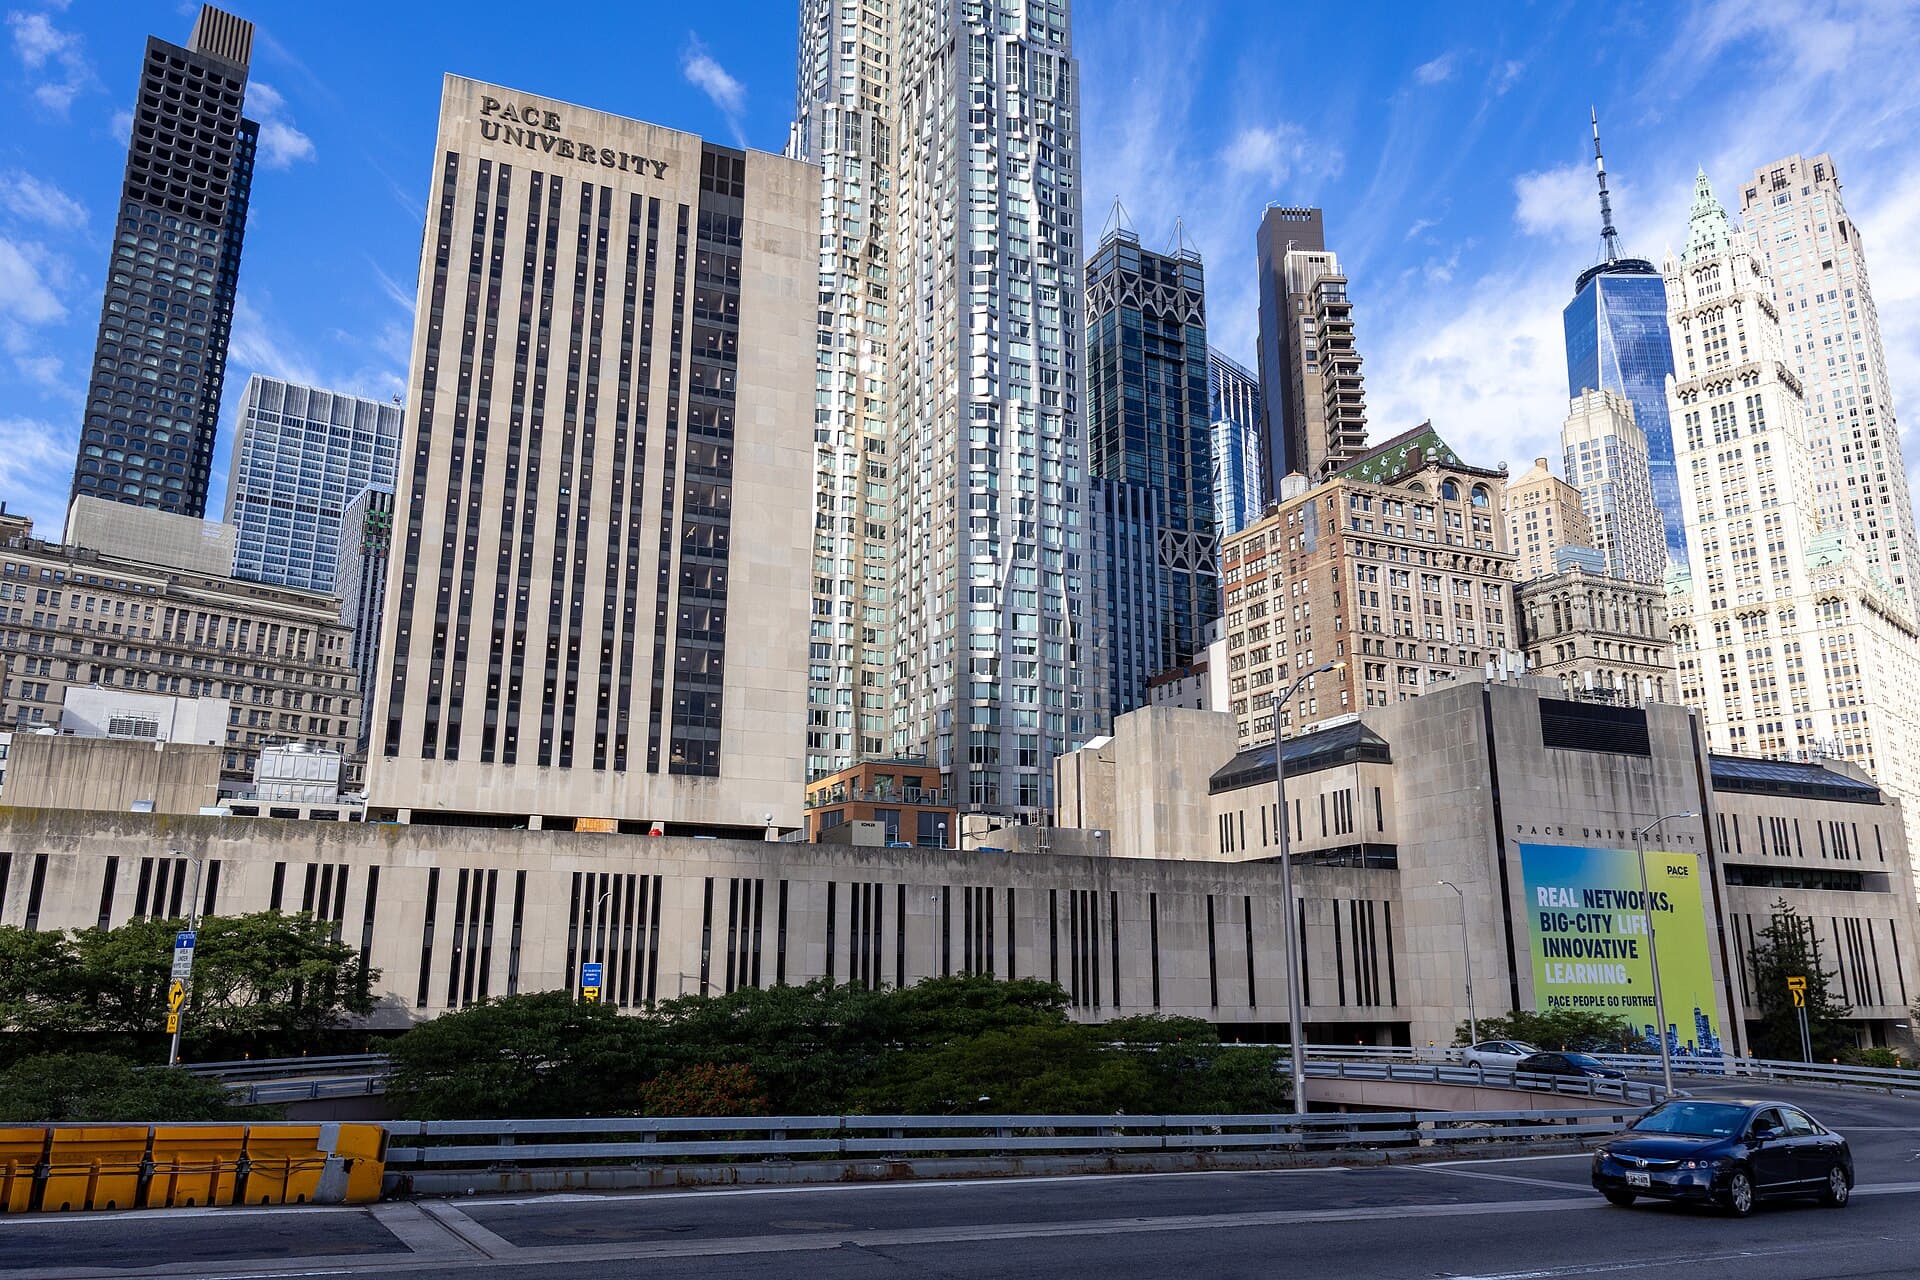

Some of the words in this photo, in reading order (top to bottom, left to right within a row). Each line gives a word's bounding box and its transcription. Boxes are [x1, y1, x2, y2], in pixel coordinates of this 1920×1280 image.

[480, 95, 561, 132] PACE
[480, 118, 669, 180] UNIVERSITY
[1517, 825, 1564, 836] PACE
[1584, 828, 1695, 844] UNIVERSITY
[1667, 866, 1688, 876] PACE
[1537, 887, 1579, 908] REAL
[1584, 889, 1674, 913] NETWORKS,
[1540, 912, 1612, 933] BIG-CITY
[1543, 937, 1639, 959] INNOVATIVE
[1545, 963, 1632, 984] LEARNING.
[1548, 995, 1571, 1007] PACE
[1573, 995, 1605, 1007] PEOPLE
[1607, 996, 1619, 1007] GO
